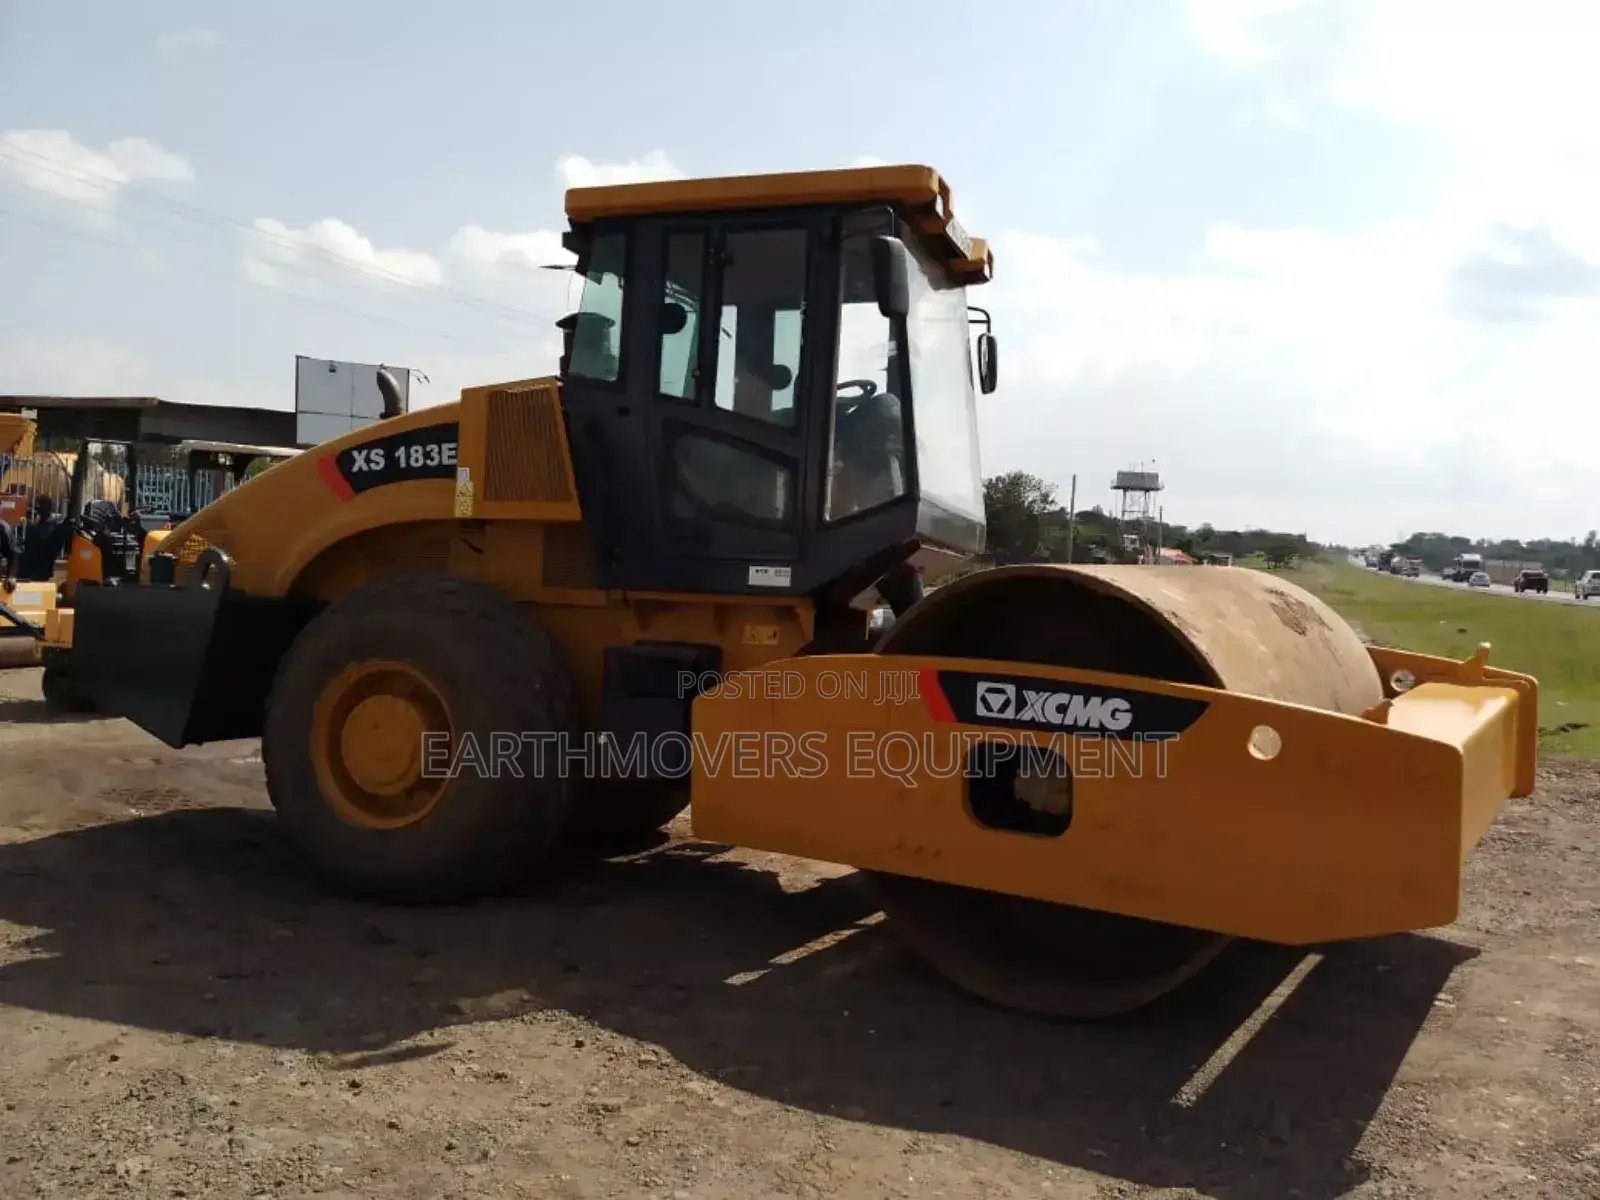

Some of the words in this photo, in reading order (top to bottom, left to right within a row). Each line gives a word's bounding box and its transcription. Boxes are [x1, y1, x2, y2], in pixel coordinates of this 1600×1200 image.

[351, 449, 386, 472] XS
[395, 443, 457, 468] 183E
[1015, 690, 1133, 730] XCMG
